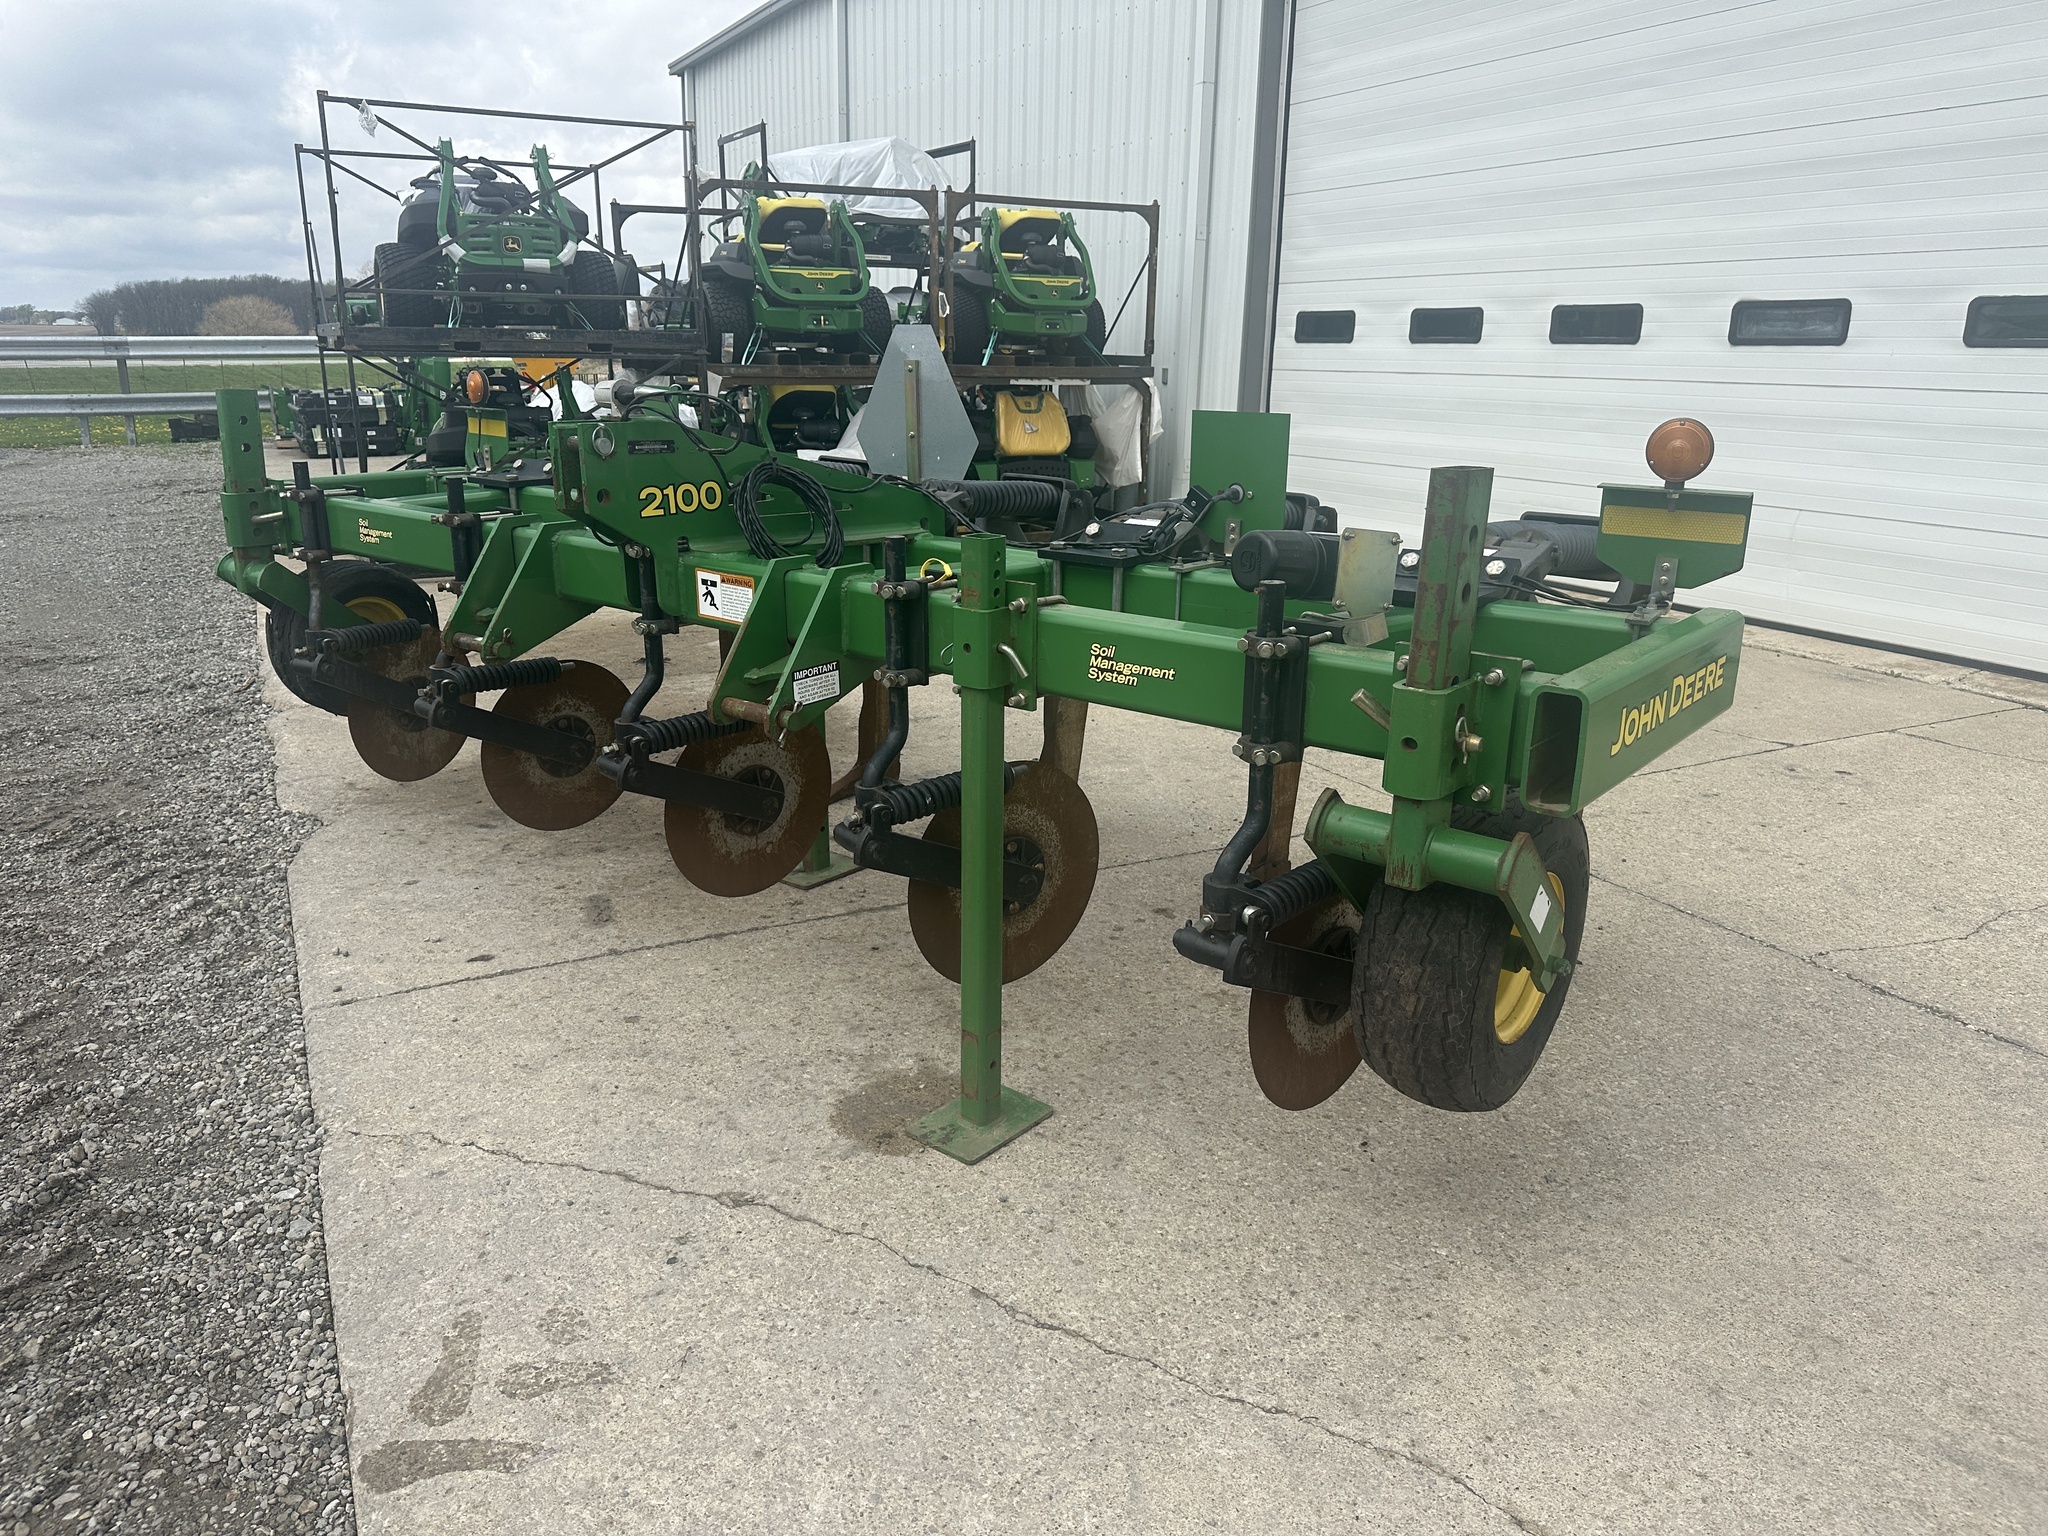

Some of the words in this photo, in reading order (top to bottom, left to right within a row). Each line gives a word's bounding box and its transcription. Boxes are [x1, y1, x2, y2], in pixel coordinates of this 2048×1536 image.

[638, 480, 723, 518] 2100
[358, 518, 368, 526] Soil
[360, 526, 392, 538] Management
[360, 534, 380, 544] System
[726, 578, 752, 588] WARNING
[1090, 644, 1116, 658] Soil
[794, 662, 837, 680] IMPORTANT
[1090, 656, 1175, 680] Management
[1088, 668, 1138, 686] System
[1610, 690, 1668, 756] JOHN
[1669, 655, 1726, 718] DEERE
